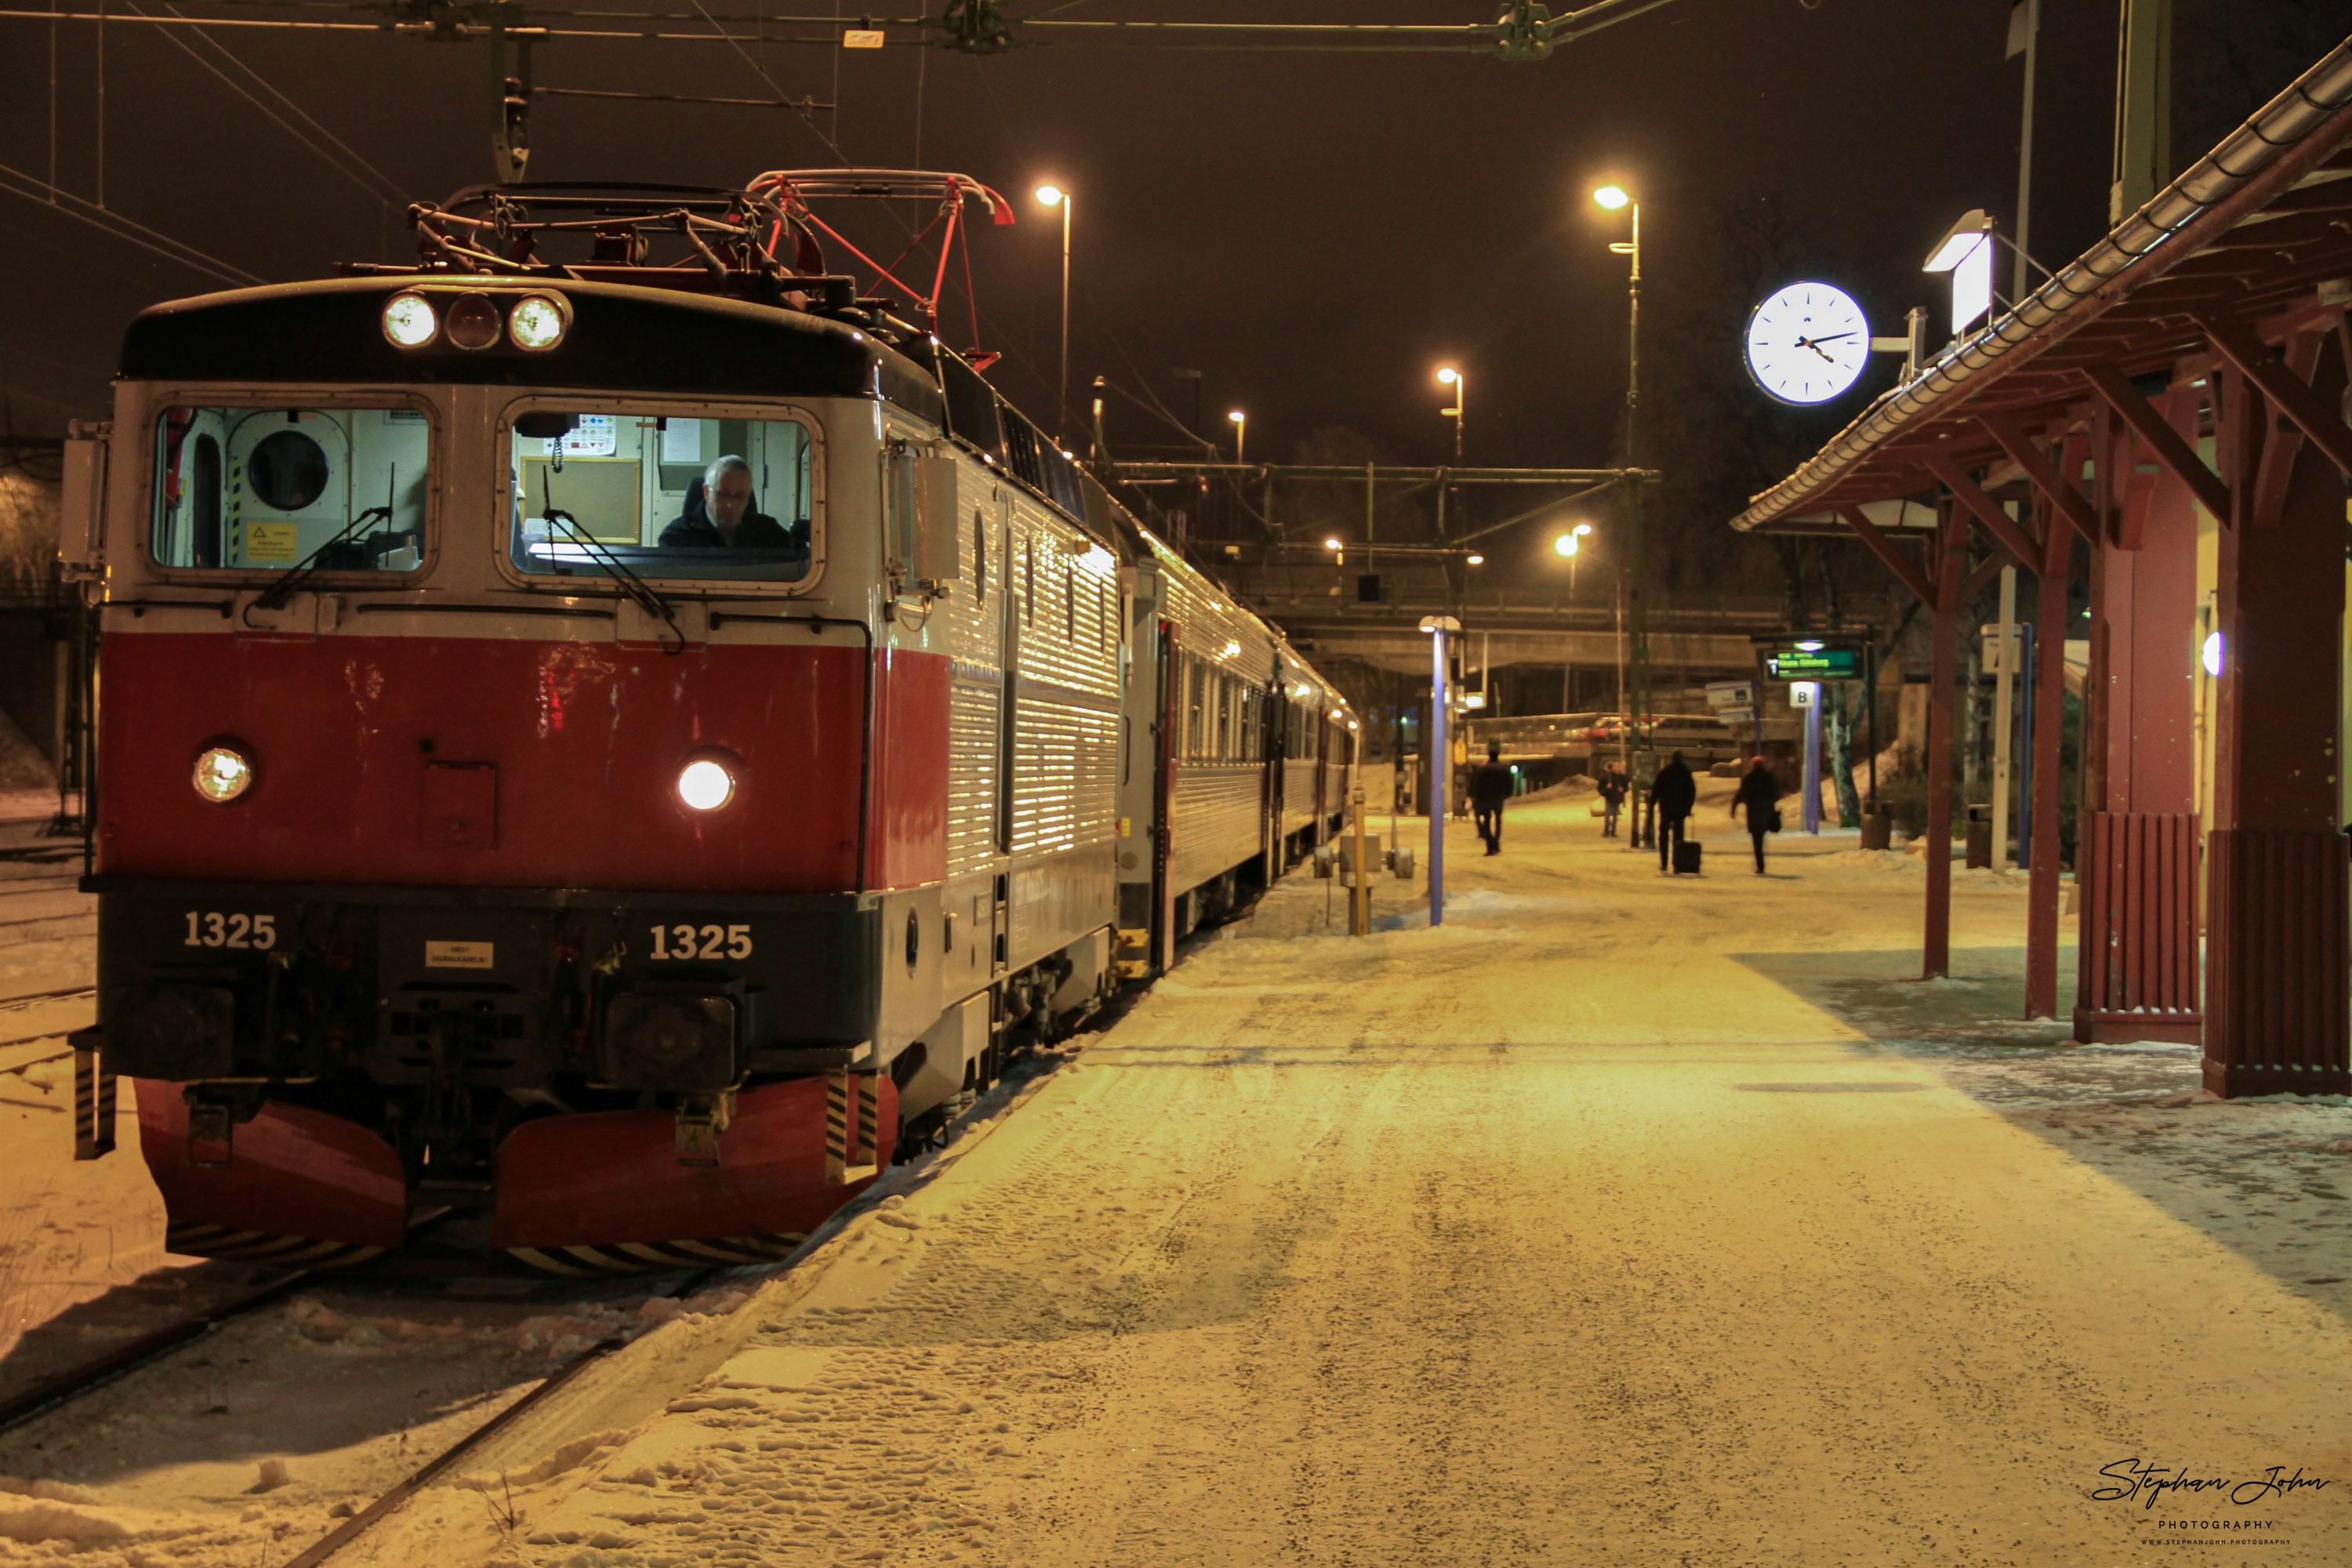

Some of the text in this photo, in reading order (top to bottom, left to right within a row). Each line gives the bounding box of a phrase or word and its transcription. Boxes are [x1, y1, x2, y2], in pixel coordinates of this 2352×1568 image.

[1798, 691, 1807, 703] B
[184, 911, 276, 949] 1325
[650, 924, 753, 960] 1325
